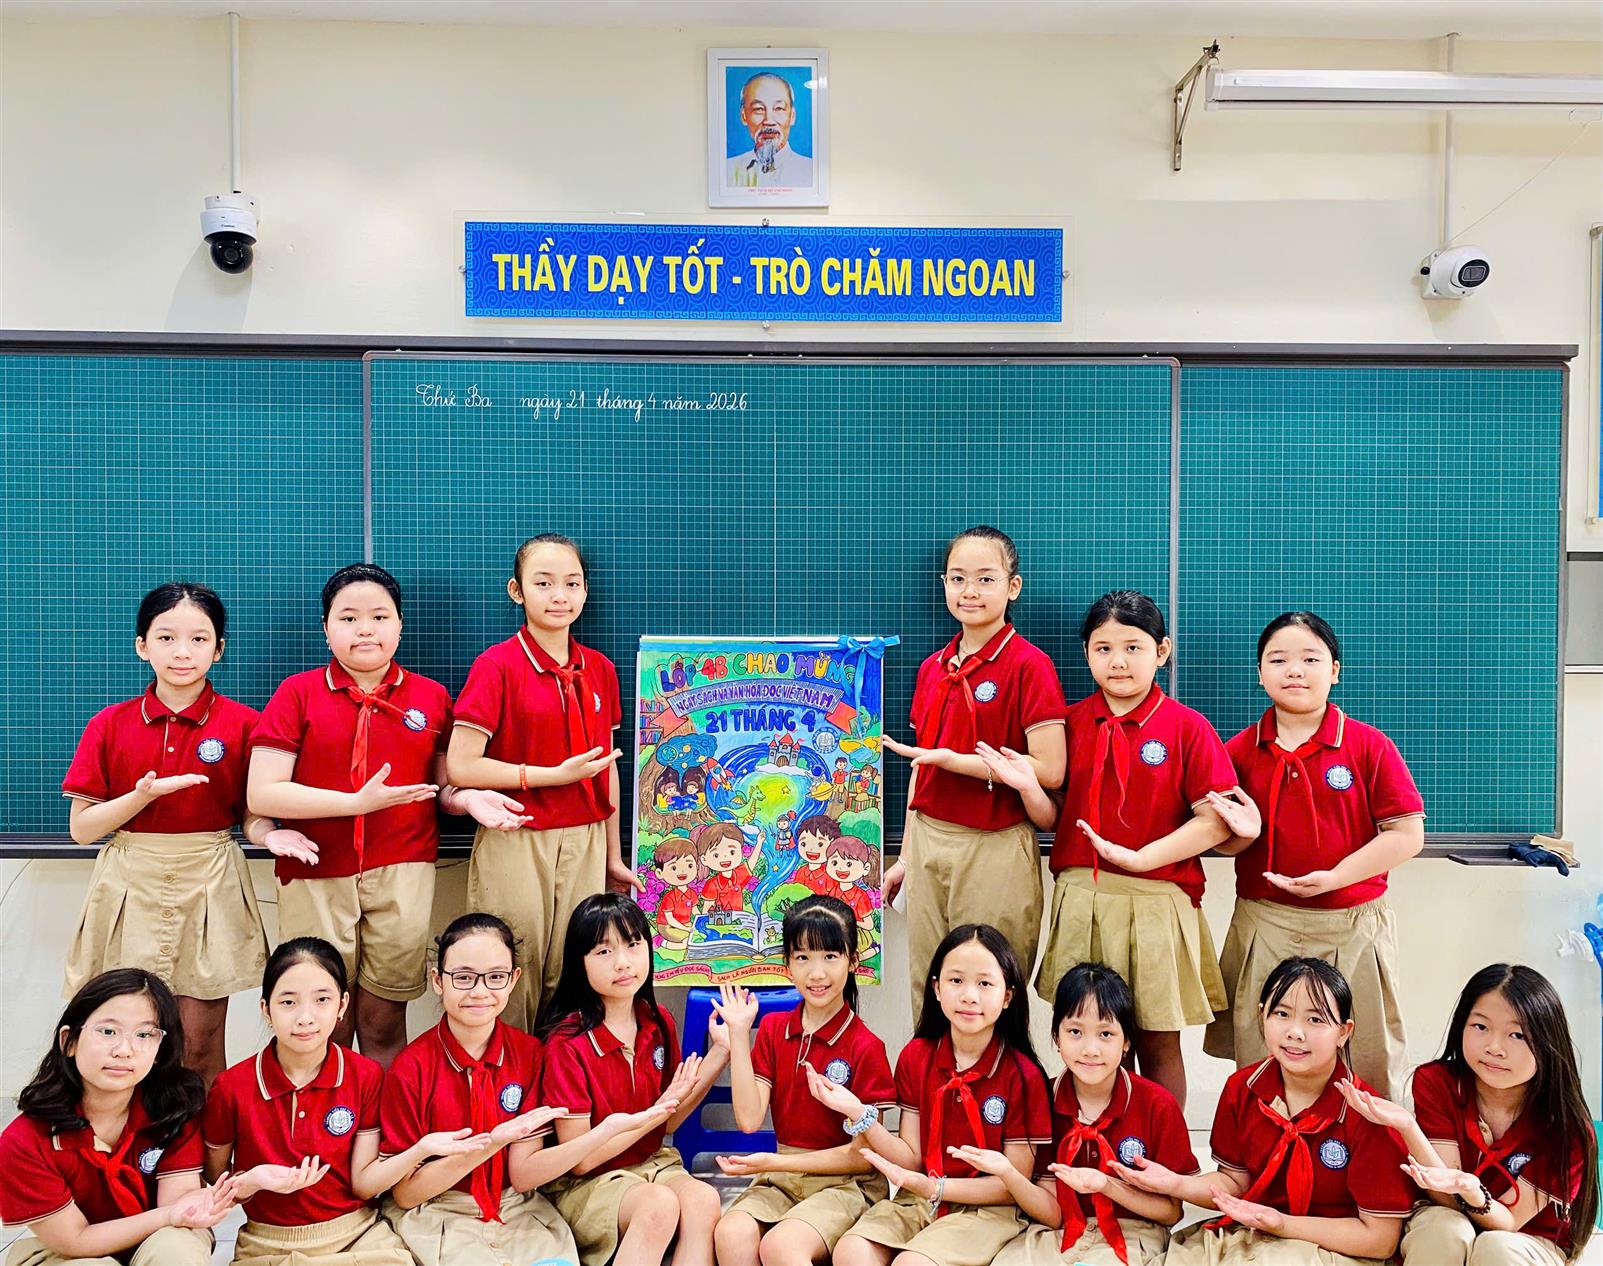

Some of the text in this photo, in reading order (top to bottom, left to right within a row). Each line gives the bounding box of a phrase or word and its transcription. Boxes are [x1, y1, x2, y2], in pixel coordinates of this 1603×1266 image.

[492, 238, 577, 294] THẦY
[587, 256, 654, 305] DẠY
[663, 238, 724, 294] TỐT
[750, 247, 811, 295] TRÒ
[821, 248, 912, 296] CHĂM
[923, 258, 1036, 297] NGOAN
[416, 384, 748, 422] Thứ Ba ngày 21 tháng 4 năm 2026
[701, 655, 728, 680] 4B
[803, 688, 834, 708] NAM
[705, 703, 816, 733] 21 THÁNG 4
